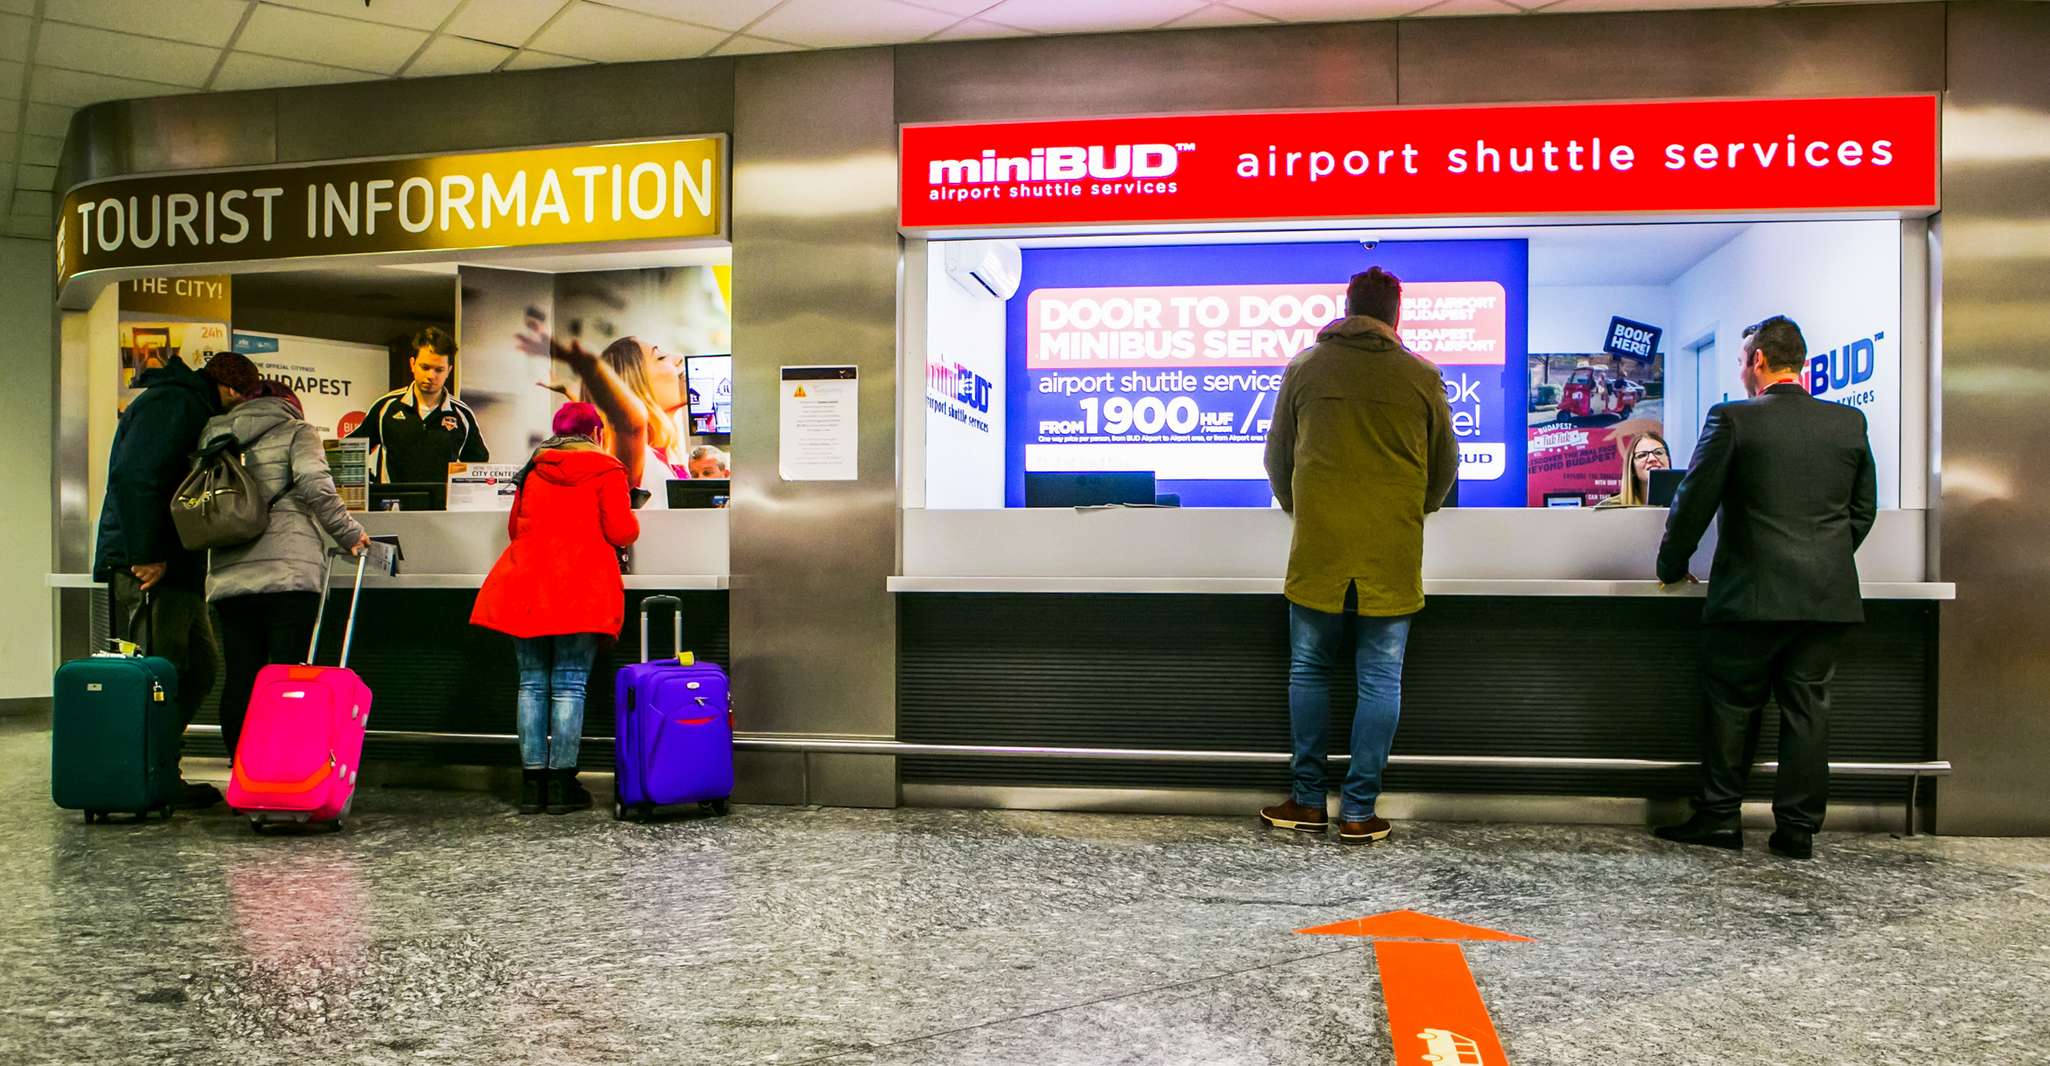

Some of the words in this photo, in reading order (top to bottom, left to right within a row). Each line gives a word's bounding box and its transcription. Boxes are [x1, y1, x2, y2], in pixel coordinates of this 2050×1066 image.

[1236, 144, 1419, 182] airport
[1447, 137, 1636, 173] shuttle
[1664, 133, 1894, 170] services
[929, 184, 1001, 201] airport
[1010, 182, 1082, 198] shuttle
[1091, 180, 1178, 194] services
[77, 187, 284, 255] TOURIST
[307, 158, 712, 239] INFORMATION
[176, 279, 223, 299] CITY!
[1434, 296, 1497, 309] AIRPORT
[1039, 297, 1162, 330] DOOR
[1170, 296, 1230, 328] TO
[1402, 309, 1476, 321] BUDAPEST
[202, 327, 224, 339] 24h
[1402, 328, 1475, 341] BUDAPEST
[1614, 323, 1654, 344] BOOK
[1039, 329, 1195, 361] MINIBUS
[1203, 327, 1320, 359] SERVI
[1434, 339, 1497, 352] AIRPORT
[1610, 335, 1651, 357] HERE!
[1038, 371, 1115, 396] airport
[1120, 370, 1198, 393] shuttle
[1202, 369, 1283, 393] service
[1039, 420, 1085, 435] FROM
[1080, 396, 1200, 435] 1900
[1200, 411, 1234, 426] HUF
[1126, 434, 1140, 442] BUD
[1537, 422, 1573, 435] BUDAPEST
[1566, 452, 1617, 468] BUDAPEST
